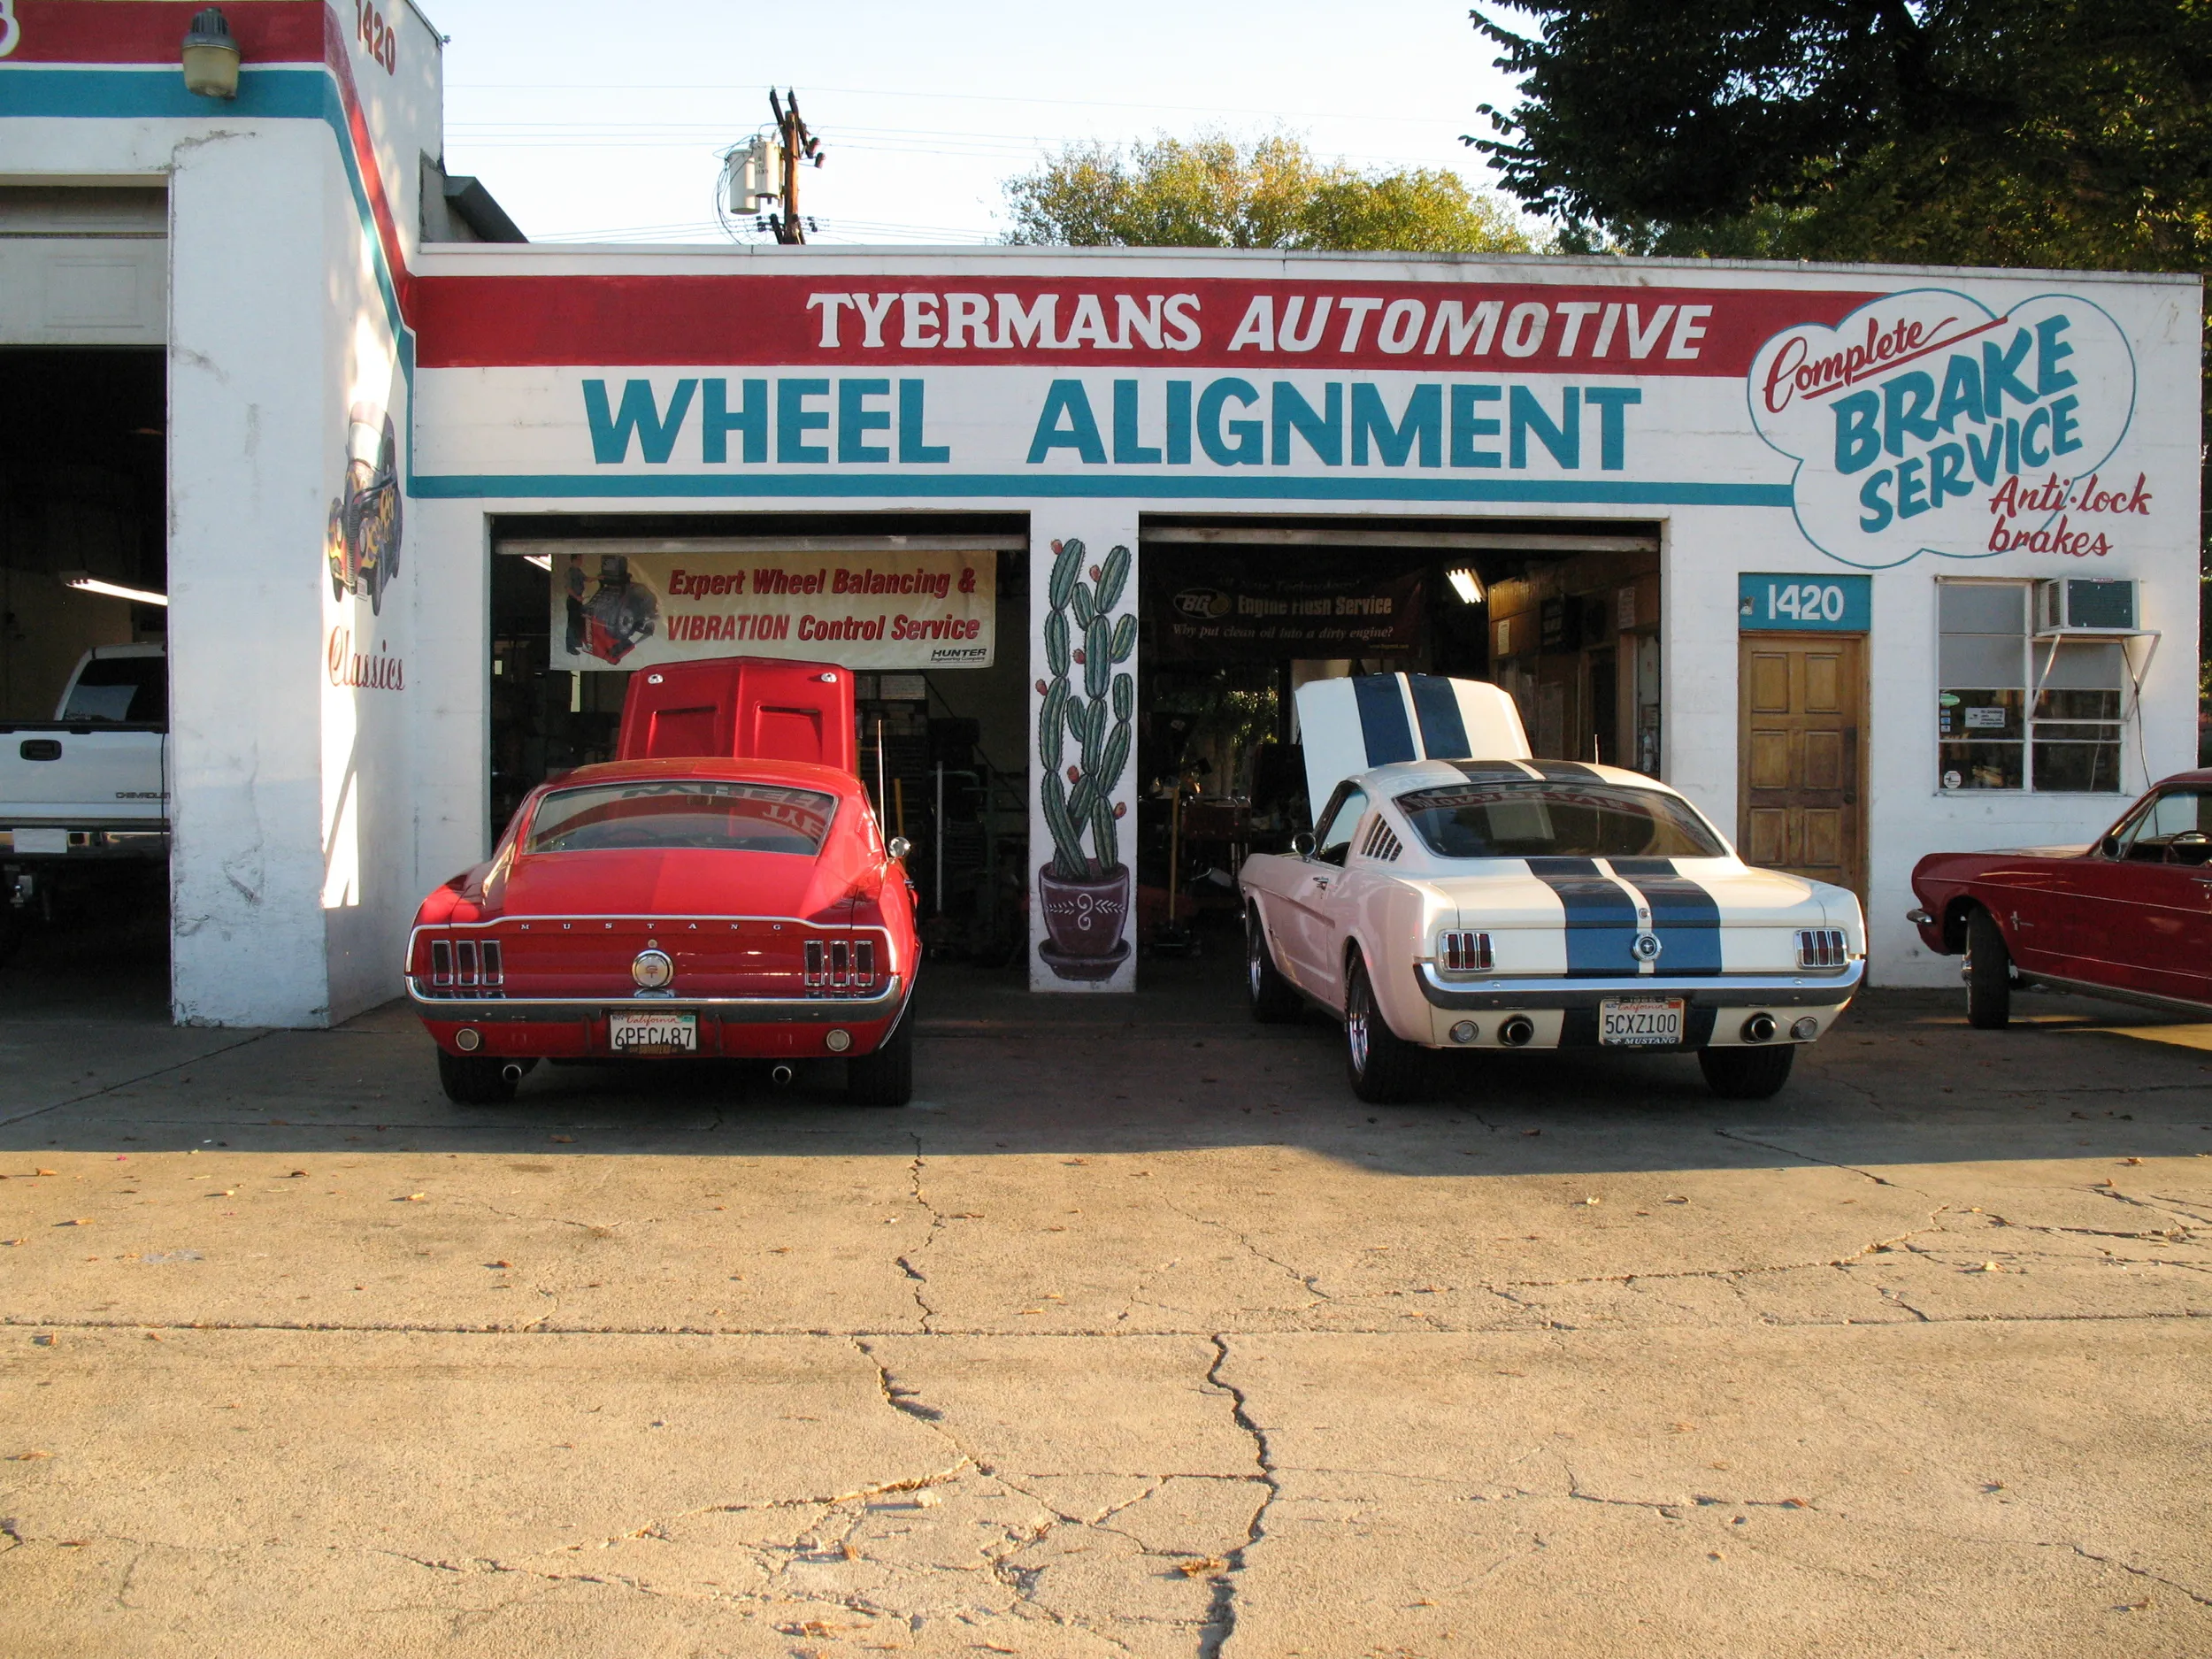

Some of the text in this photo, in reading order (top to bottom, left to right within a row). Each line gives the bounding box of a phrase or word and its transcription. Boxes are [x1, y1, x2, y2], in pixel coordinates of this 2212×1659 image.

[355, 0, 396, 76] 1420
[806, 292, 1713, 359] TYERMANS AUTOMOTIVE
[1763, 316, 1959, 414] Complete
[1830, 314, 2078, 475] BRAKE
[582, 377, 1641, 471] WHEEL ALIGNMENT
[1859, 394, 2083, 534] SERVICE
[1988, 514, 2114, 557] brakes
[668, 568, 975, 601] Expert Wheel Balancing &
[1238, 595, 1288, 618] Engine
[1335, 595, 1393, 616] Service
[1768, 584, 1845, 622] 1420
[667, 613, 980, 641] VIBRATION Control Service
[1199, 626, 1220, 639] put
[1224, 625, 1256, 638] clean
[1259, 626, 1276, 638] oil
[1318, 626, 1346, 641] dirty
[1349, 626, 1394, 641] engine?
[328, 626, 405, 691] Classics
[932, 649, 987, 657] HUNTER
[520, 922, 781, 931] MUSTANG
[626, 1014, 682, 1026] California
[1605, 1014, 1677, 1034] 5CXZ100
[1618, 1002, 1667, 1013] California
